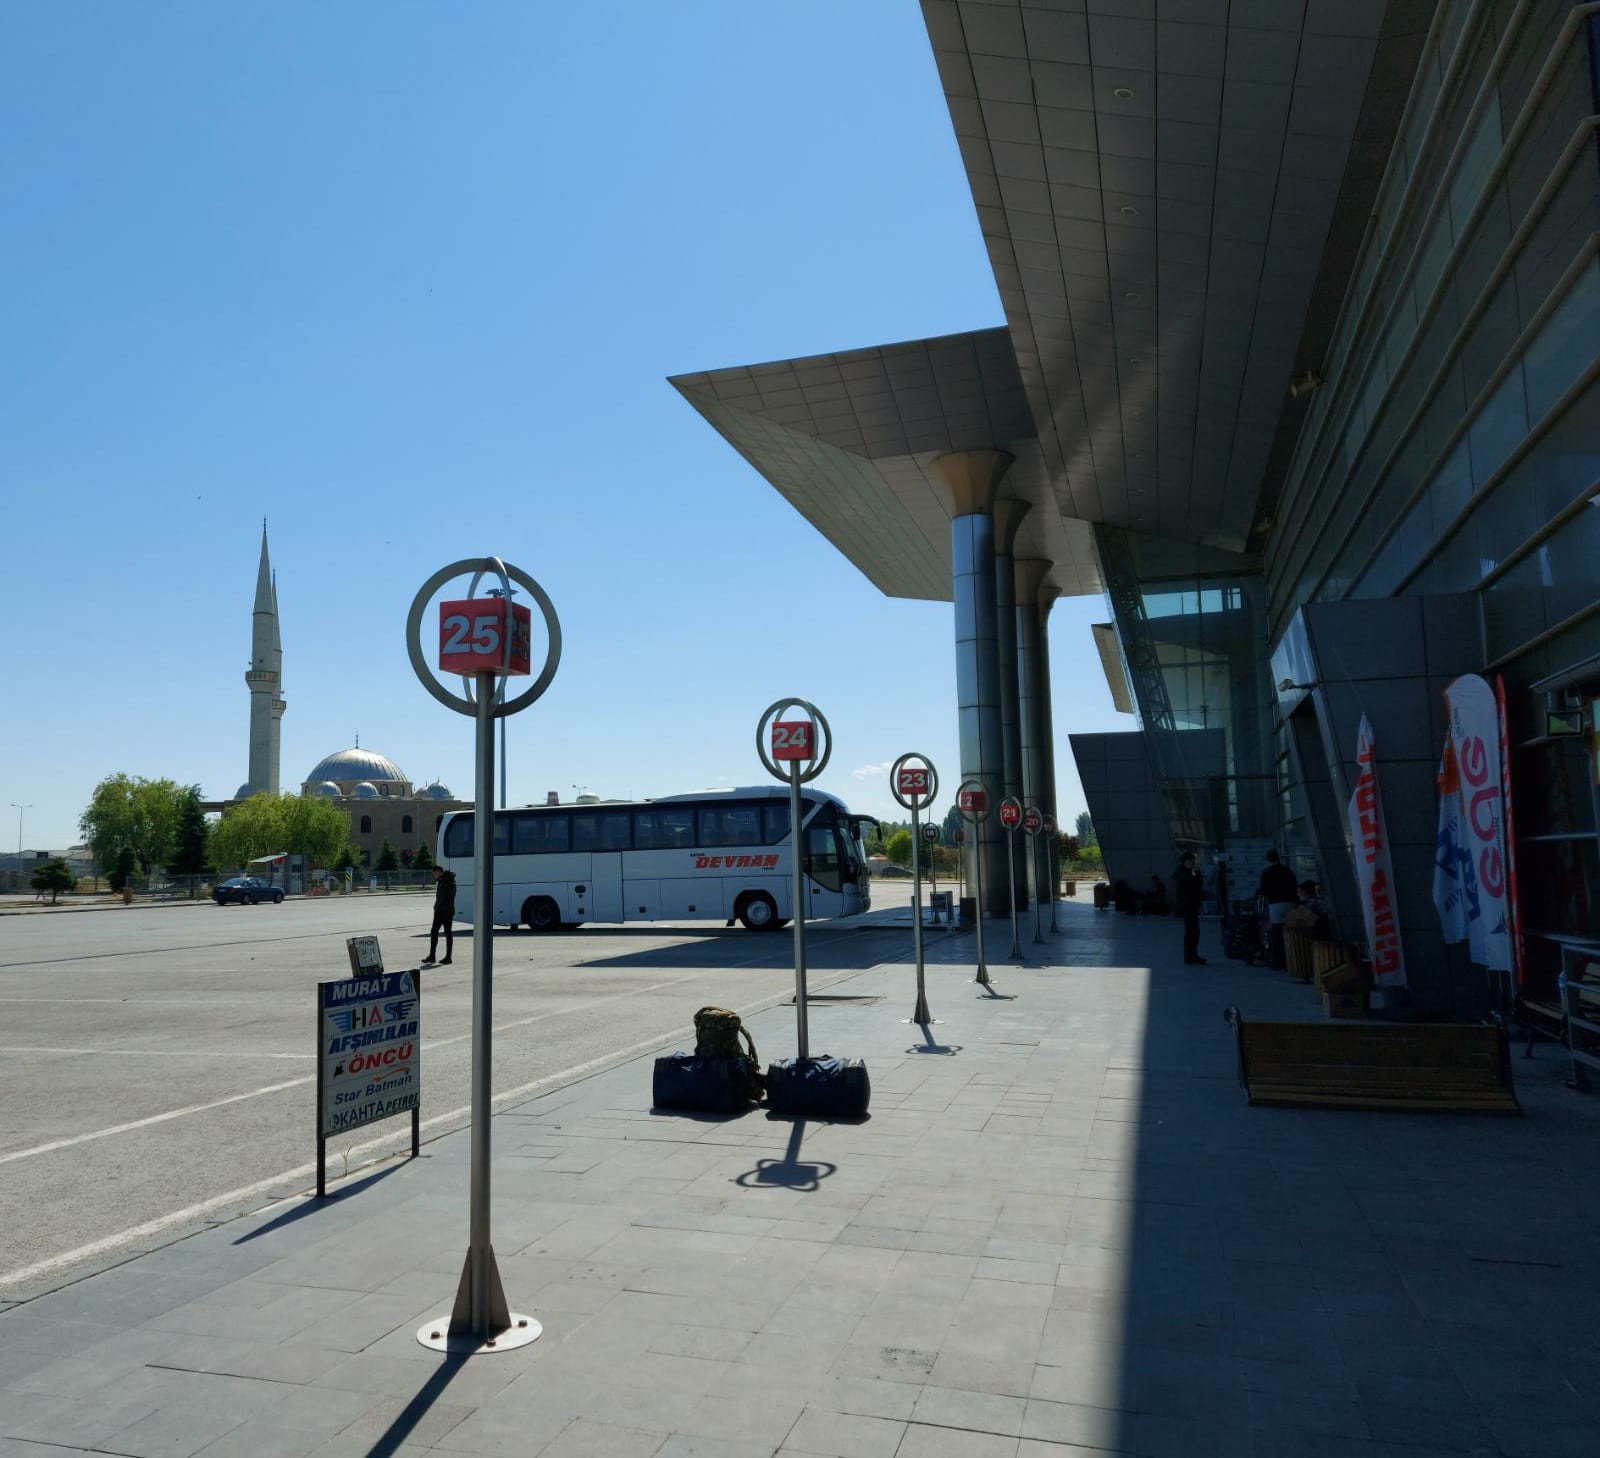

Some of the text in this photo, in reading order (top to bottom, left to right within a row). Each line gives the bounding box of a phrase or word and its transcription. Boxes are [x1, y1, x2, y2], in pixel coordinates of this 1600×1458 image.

[442, 615, 500, 655] 25
[773, 726, 807, 748] 24
[901, 772, 926, 788] 23
[1002, 808, 1016, 818] 21
[1027, 817, 1039, 826] 20
[695, 854, 779, 869] DEVRAN
[332, 977, 392, 1001] MURAT
[348, 1041, 413, 1075] ÖNCÜ
[334, 1075, 412, 1106] Star Batman
[340, 1092, 418, 1128] KAHTA PETROL
